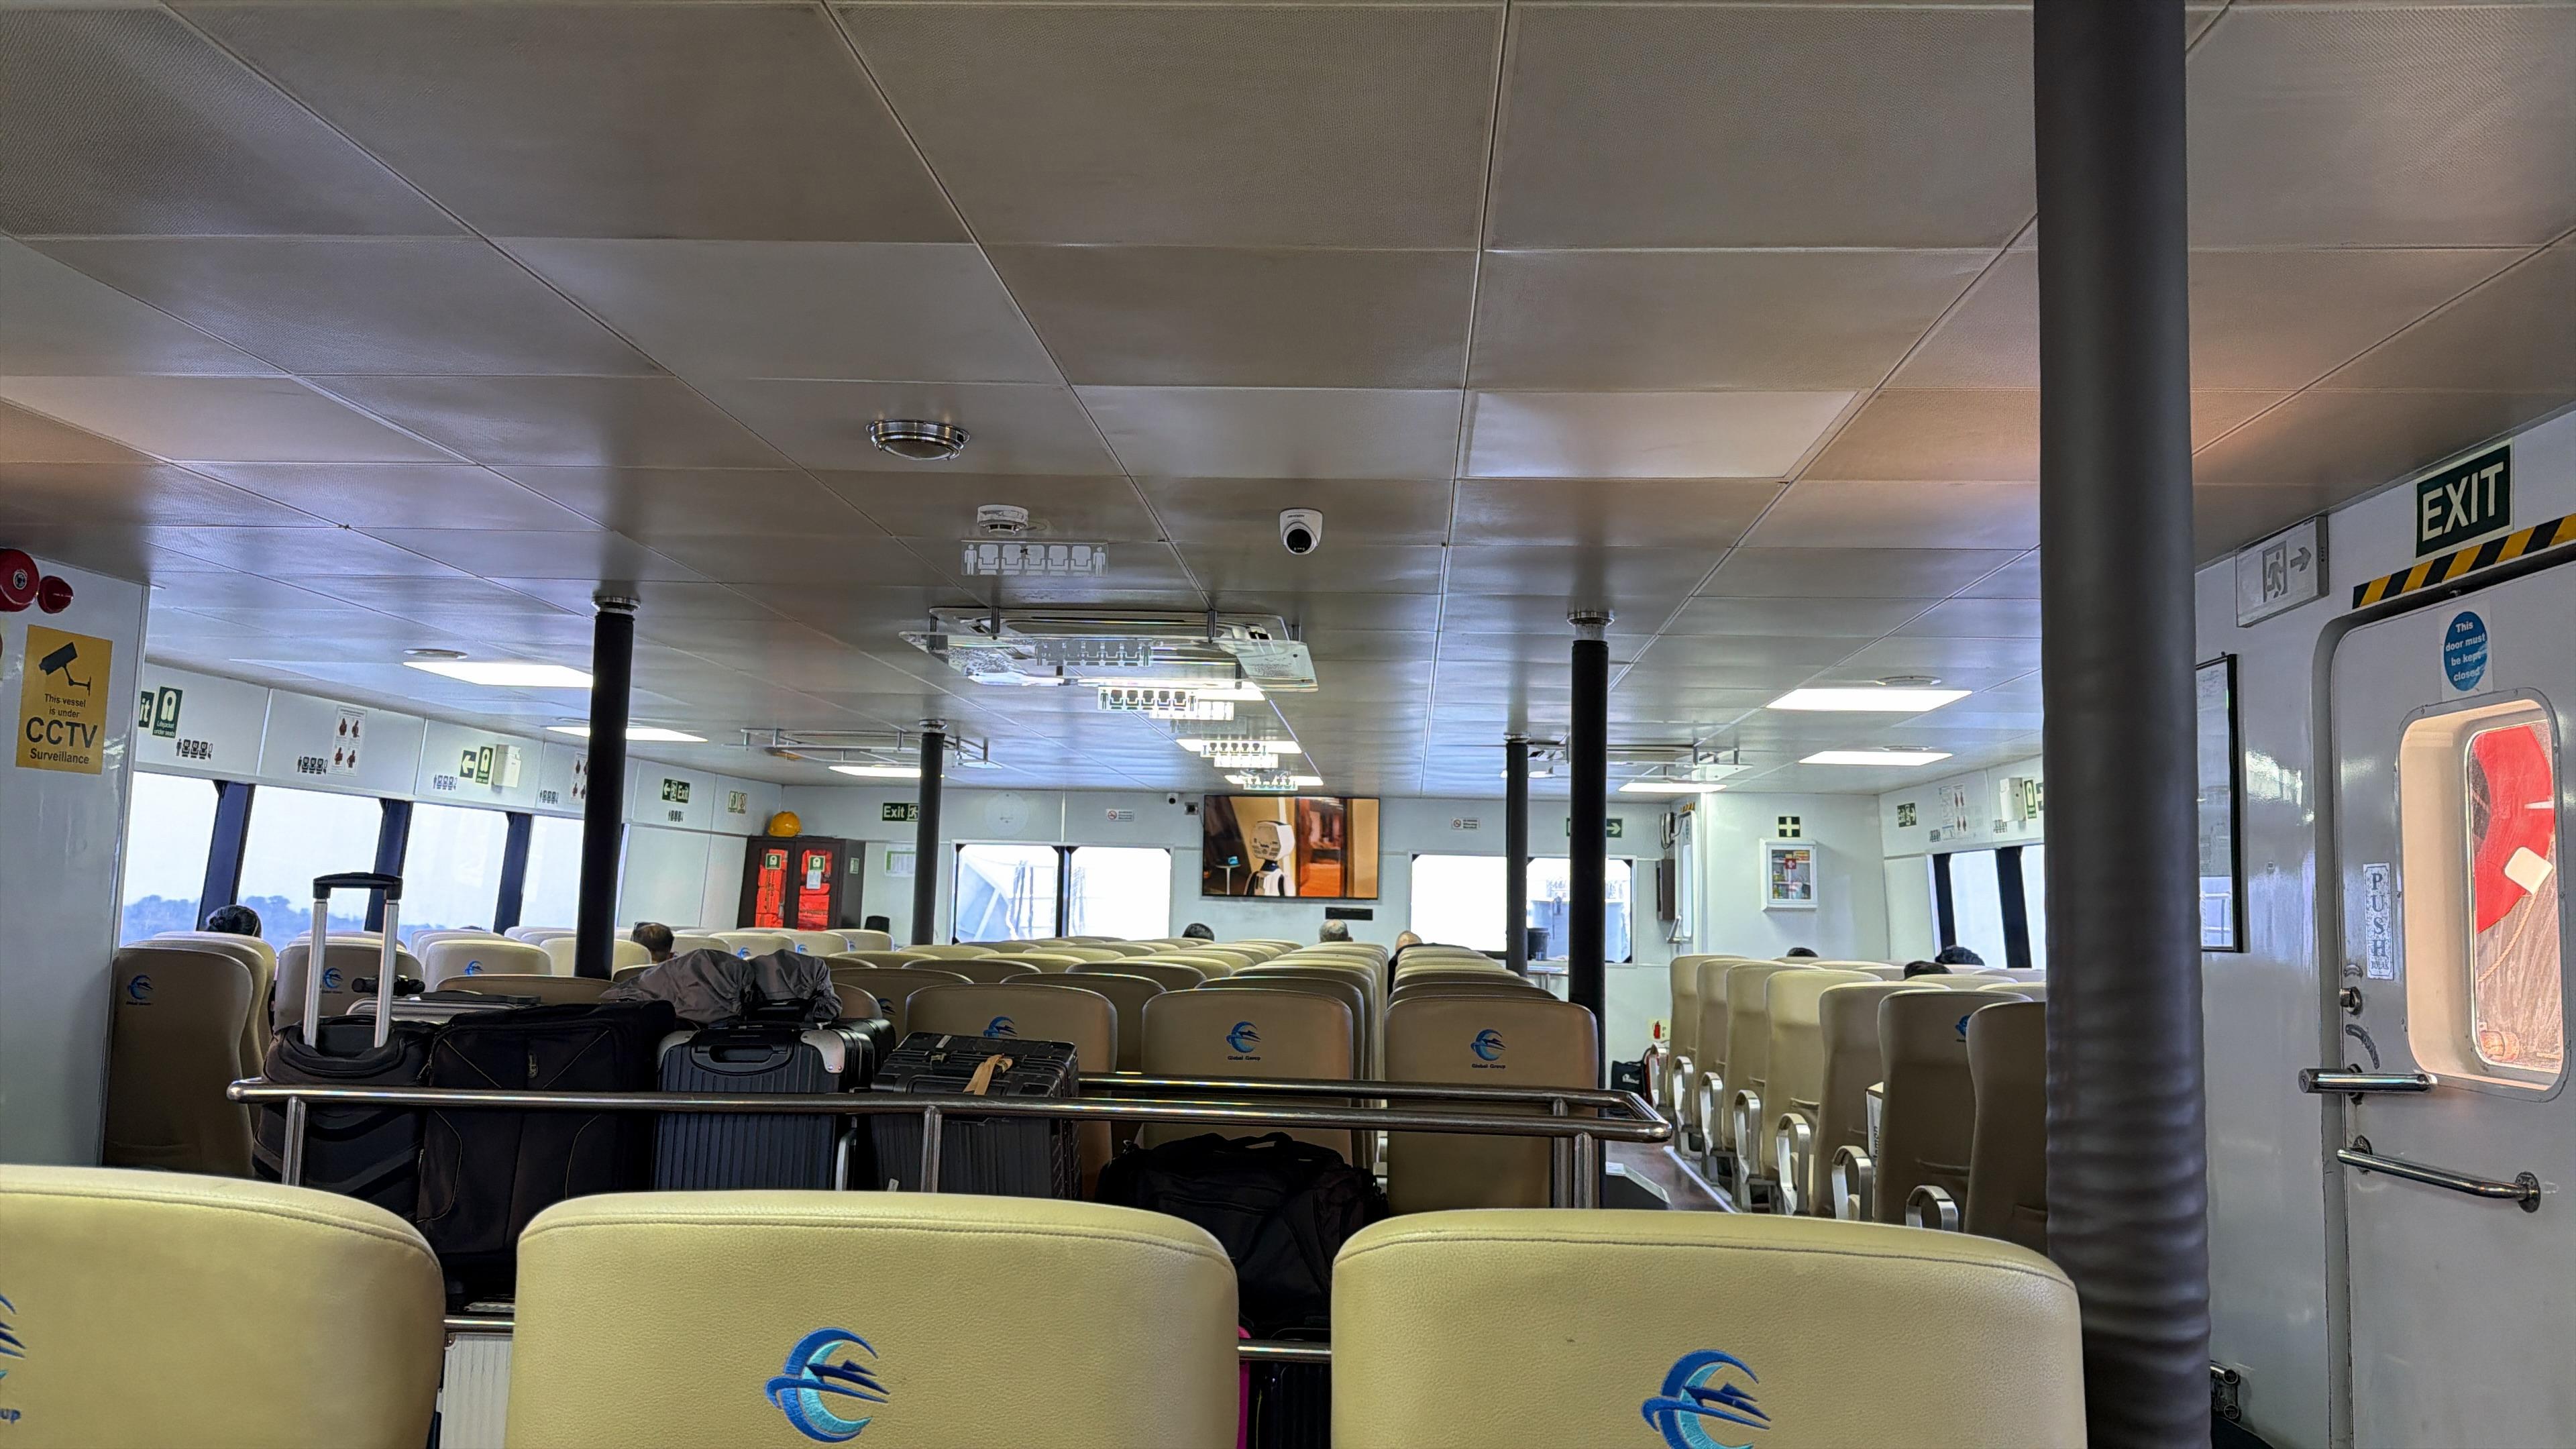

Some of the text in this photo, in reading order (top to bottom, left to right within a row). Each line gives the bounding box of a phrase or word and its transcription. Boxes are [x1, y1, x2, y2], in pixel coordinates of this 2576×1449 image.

[2422, 461, 2504, 541] EXIT
[2455, 621, 2474, 633] This
[2445, 633, 2486, 652] door must
[2451, 651, 2481, 666] be kept
[2453, 666, 2480, 682] closed
[44, 693, 86, 708] This vessel
[49, 706, 80, 718] is under
[139, 698, 150, 722] it
[25, 716, 98, 748] CCTV
[30, 747, 89, 764] Surveillance
[678, 784, 688, 800] Exit
[883, 805, 905, 818] Exit
[2371, 873, 2387, 957] PUSH
[0, 1409, 21, 1424] up
